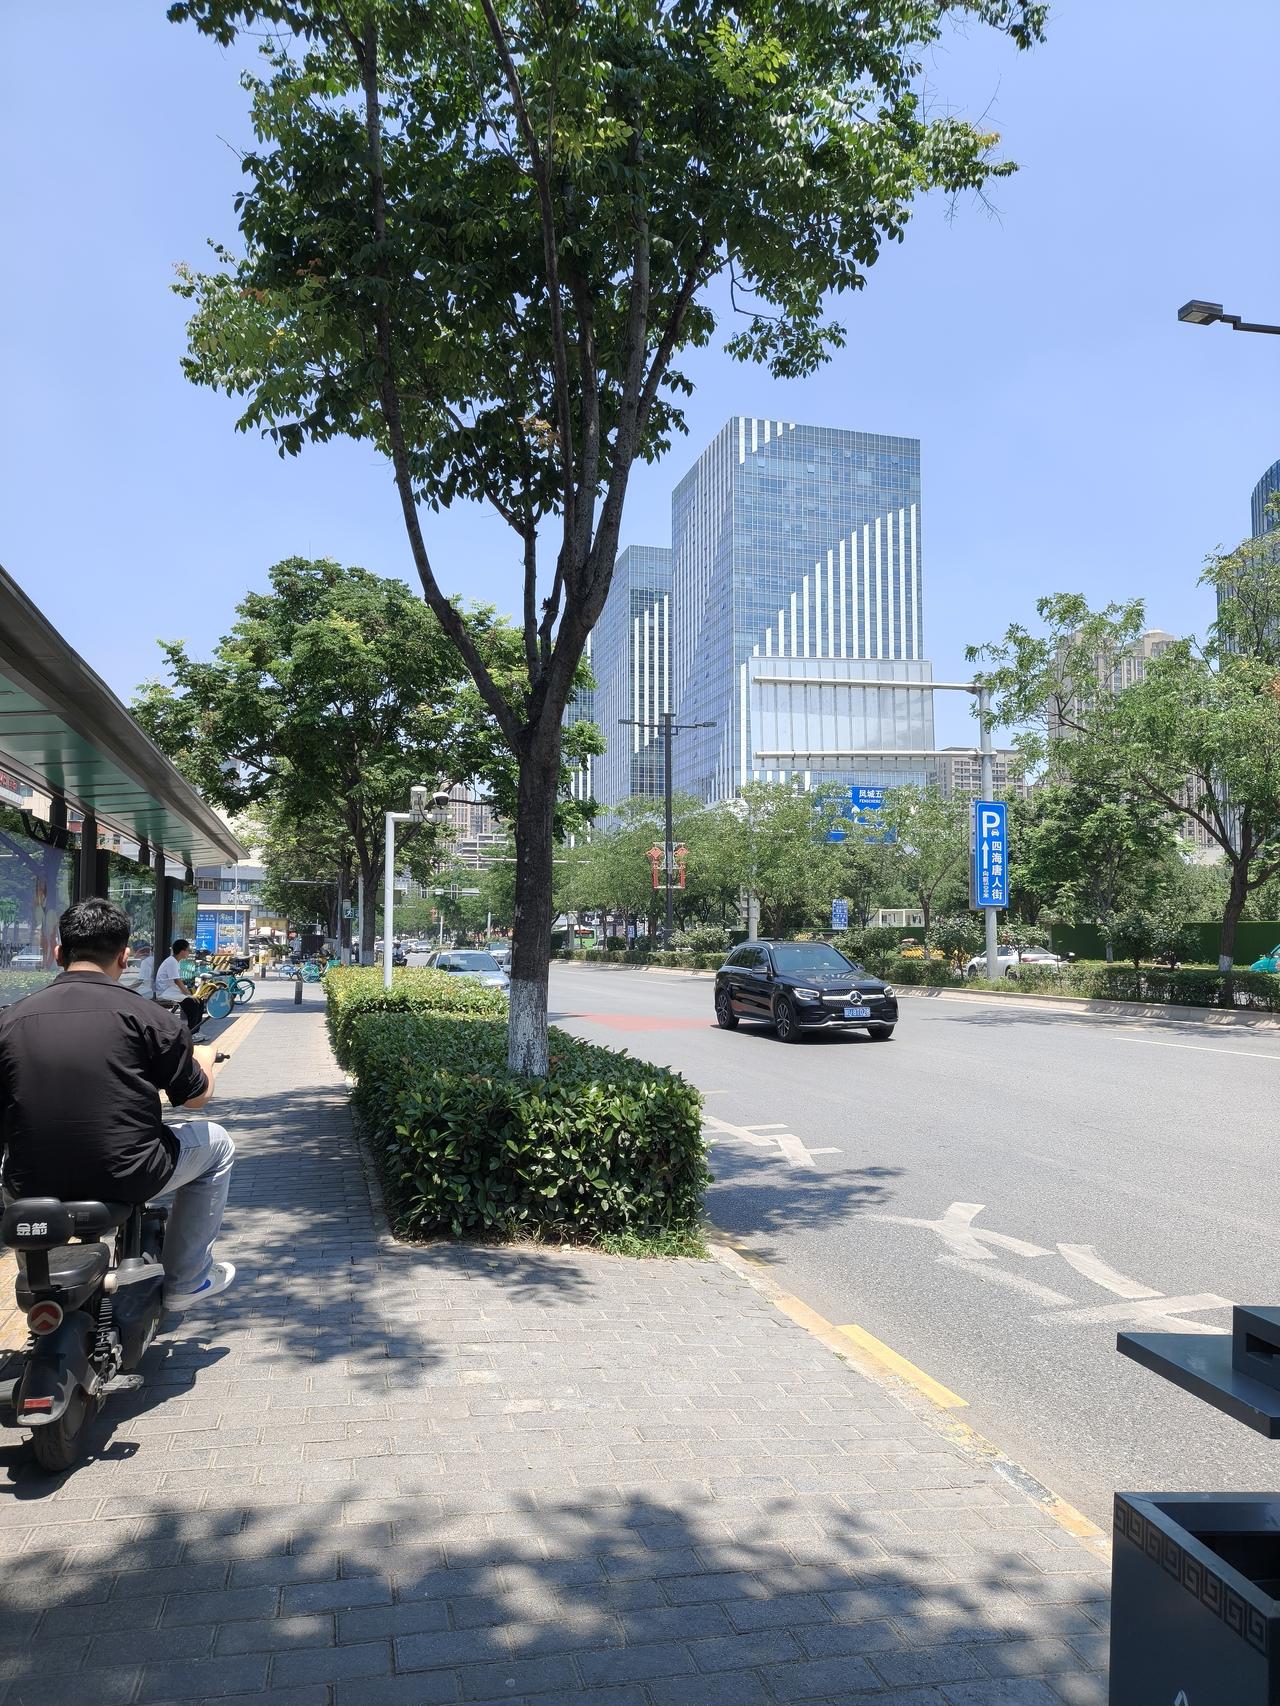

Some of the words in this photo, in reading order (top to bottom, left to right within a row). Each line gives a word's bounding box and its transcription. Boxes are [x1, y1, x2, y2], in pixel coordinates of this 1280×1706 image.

[982, 811, 1001, 838] P
[991, 841, 1003, 901] 四海唐人街
[16, 1222, 48, 1236] 金箭
